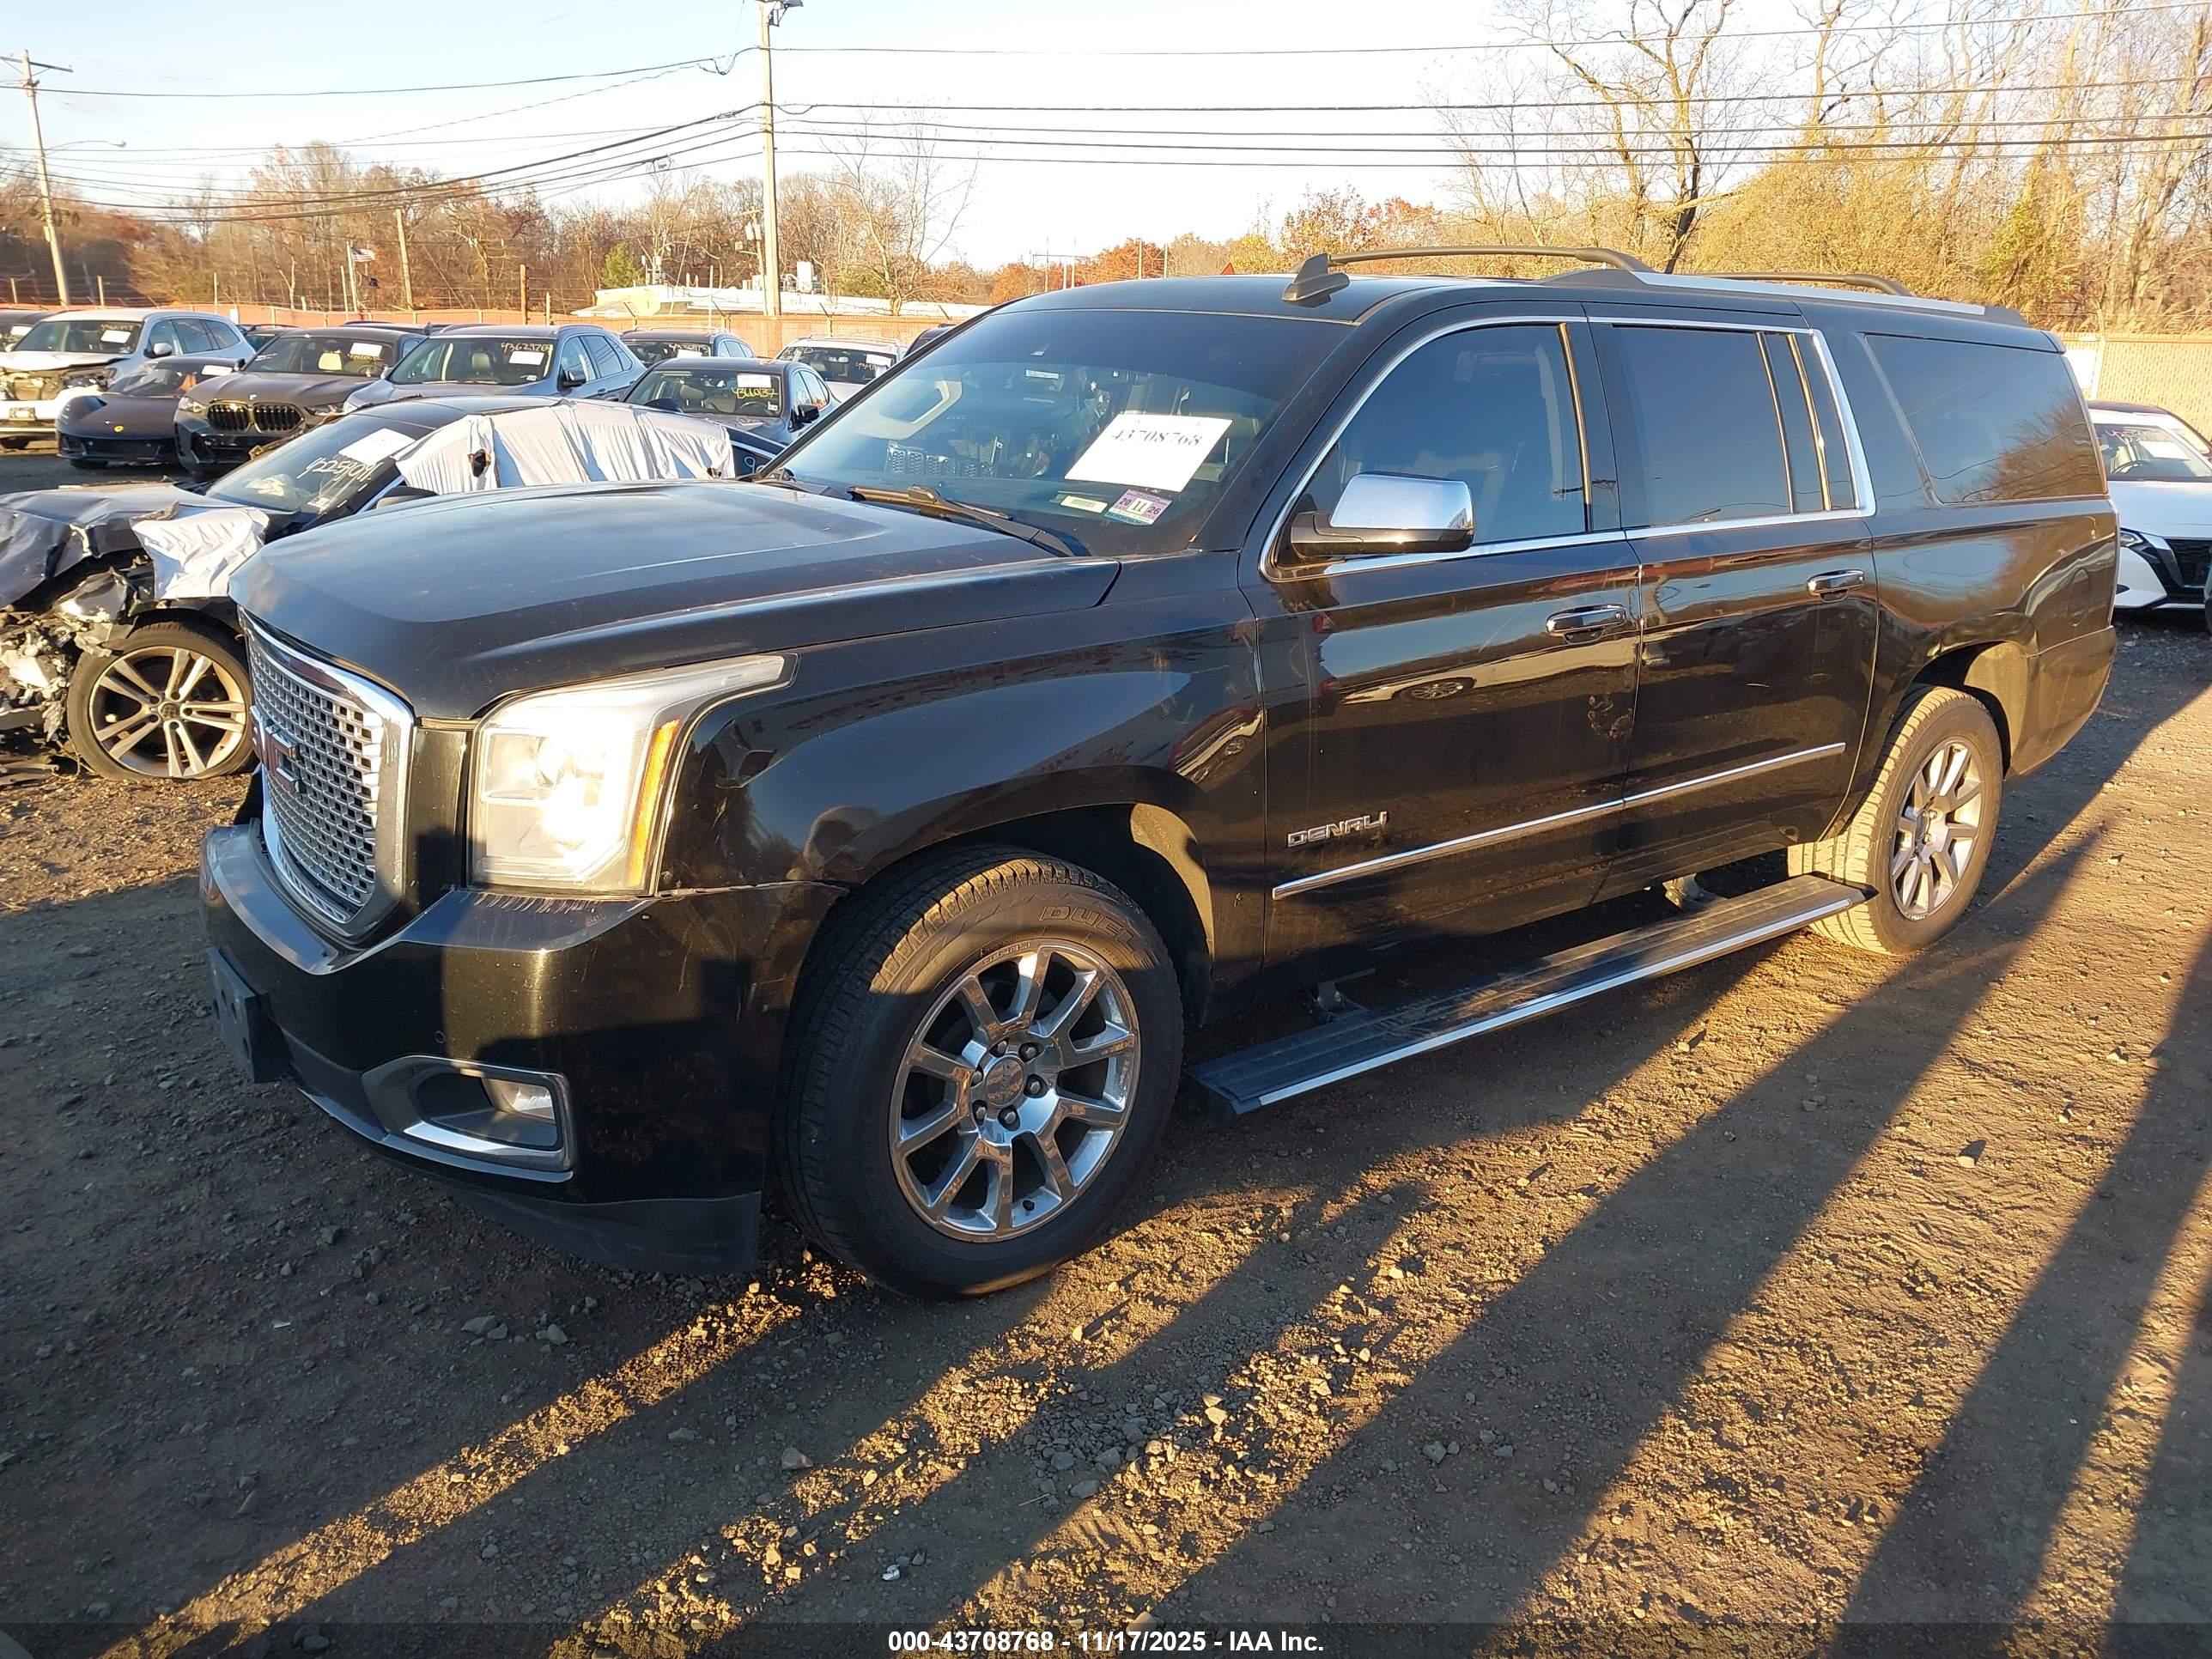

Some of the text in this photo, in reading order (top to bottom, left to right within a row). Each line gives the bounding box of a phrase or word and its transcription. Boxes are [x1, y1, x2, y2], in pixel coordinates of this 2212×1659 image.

[1112, 428, 1203, 447] 43708768
[1120, 497, 1162, 515] 20 11 26
[1287, 811, 1388, 849] DENALI
